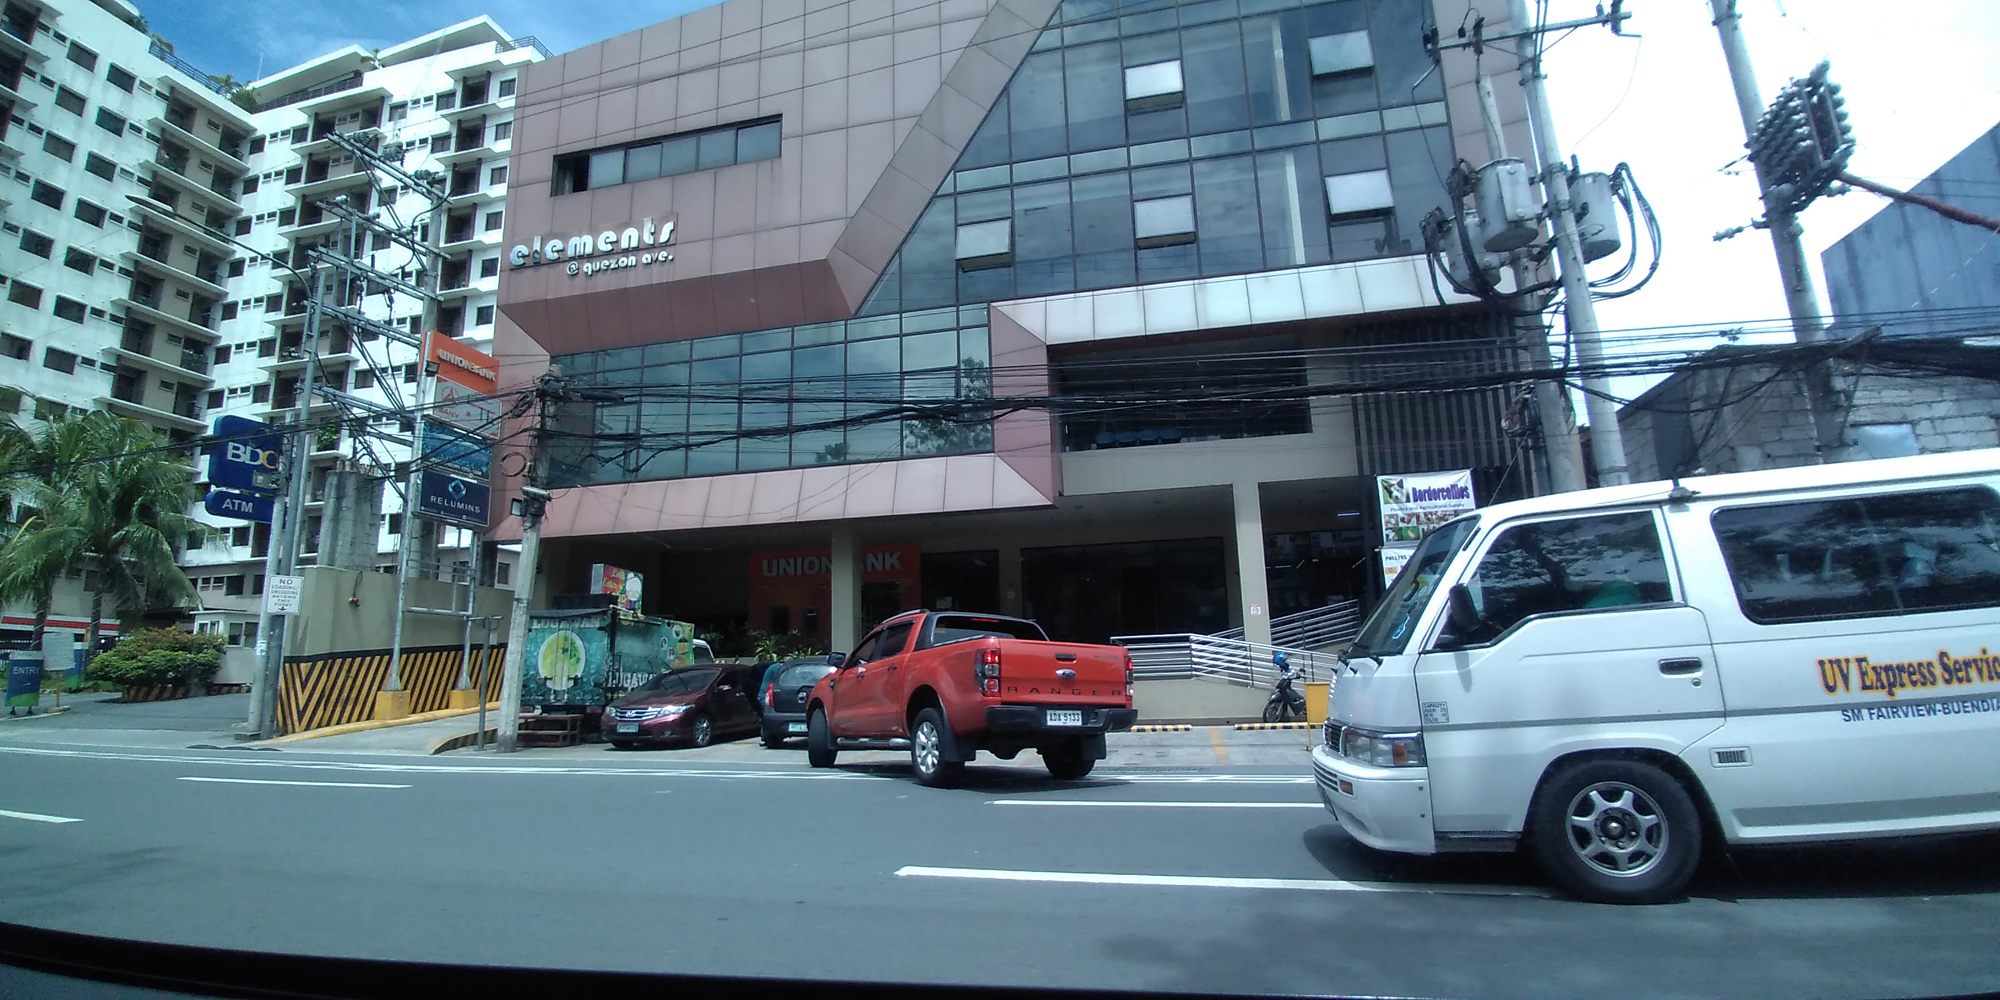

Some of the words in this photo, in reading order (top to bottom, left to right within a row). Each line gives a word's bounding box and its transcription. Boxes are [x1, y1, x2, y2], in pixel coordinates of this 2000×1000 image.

[509, 217, 676, 267] elements
[566, 261, 579, 276] @
[583, 254, 637, 277] quezon
[641, 249, 675, 264] ave.
[437, 348, 497, 382] UNIONBANK
[226, 441, 280, 470] BDO
[1411, 483, 1470, 503] Bordercollies
[222, 498, 254, 514] ATM
[430, 495, 482, 514] RELUMINS
[13, 666, 40, 675] ENTRY
[1817, 657, 1851, 694] UV
[1854, 656, 1938, 698] Express
[1007, 686, 1122, 696] RANGER
[1841, 708, 1865, 722] SM
